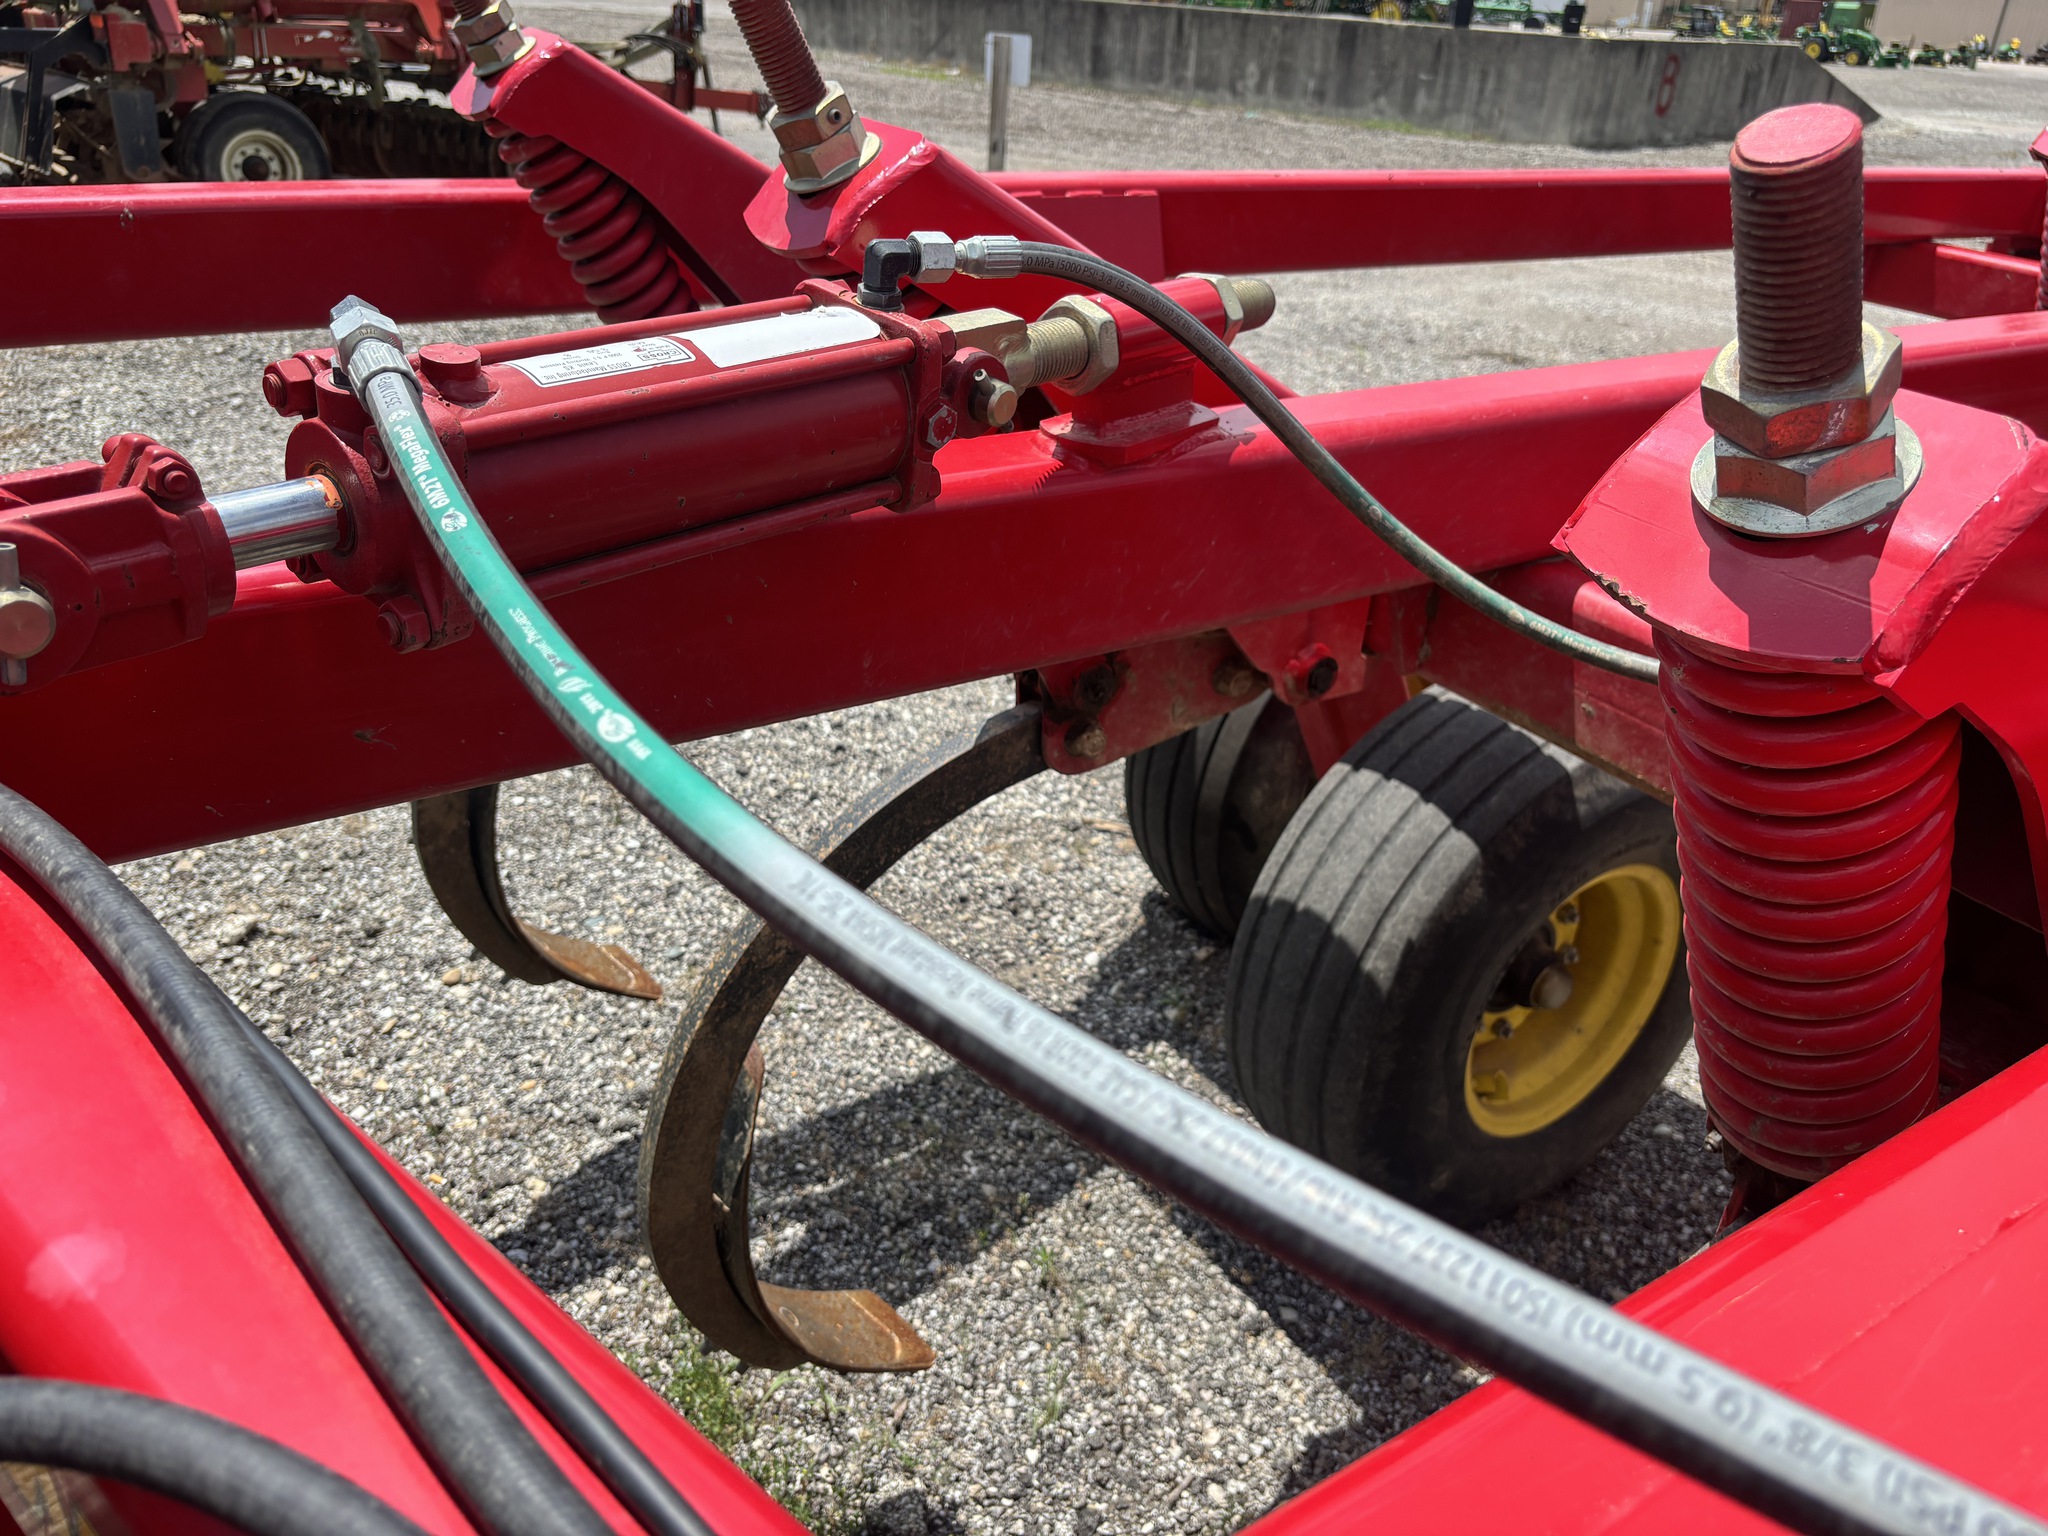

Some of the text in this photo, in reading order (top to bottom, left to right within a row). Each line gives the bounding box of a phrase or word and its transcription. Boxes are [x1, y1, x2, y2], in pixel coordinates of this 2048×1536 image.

[1034, 256, 1054, 268] MPa
[1098, 272, 1117, 284] 3/8"
[1115, 278, 1131, 292] (9.5
[1130, 288, 1148, 302] mm)
[608, 361, 631, 371] CROSS
[642, 350, 677, 360] CROSS
[377, 375, 395, 394] MPa
[557, 366, 607, 379] Manufacturing
[381, 391, 402, 409] 35.0
[1410, 1234, 1556, 1327] ISO11237
[1561, 1306, 1668, 1379] mm)
[1673, 1365, 1762, 1430] (9.5
[1762, 1410, 1868, 1486] 3/8"
